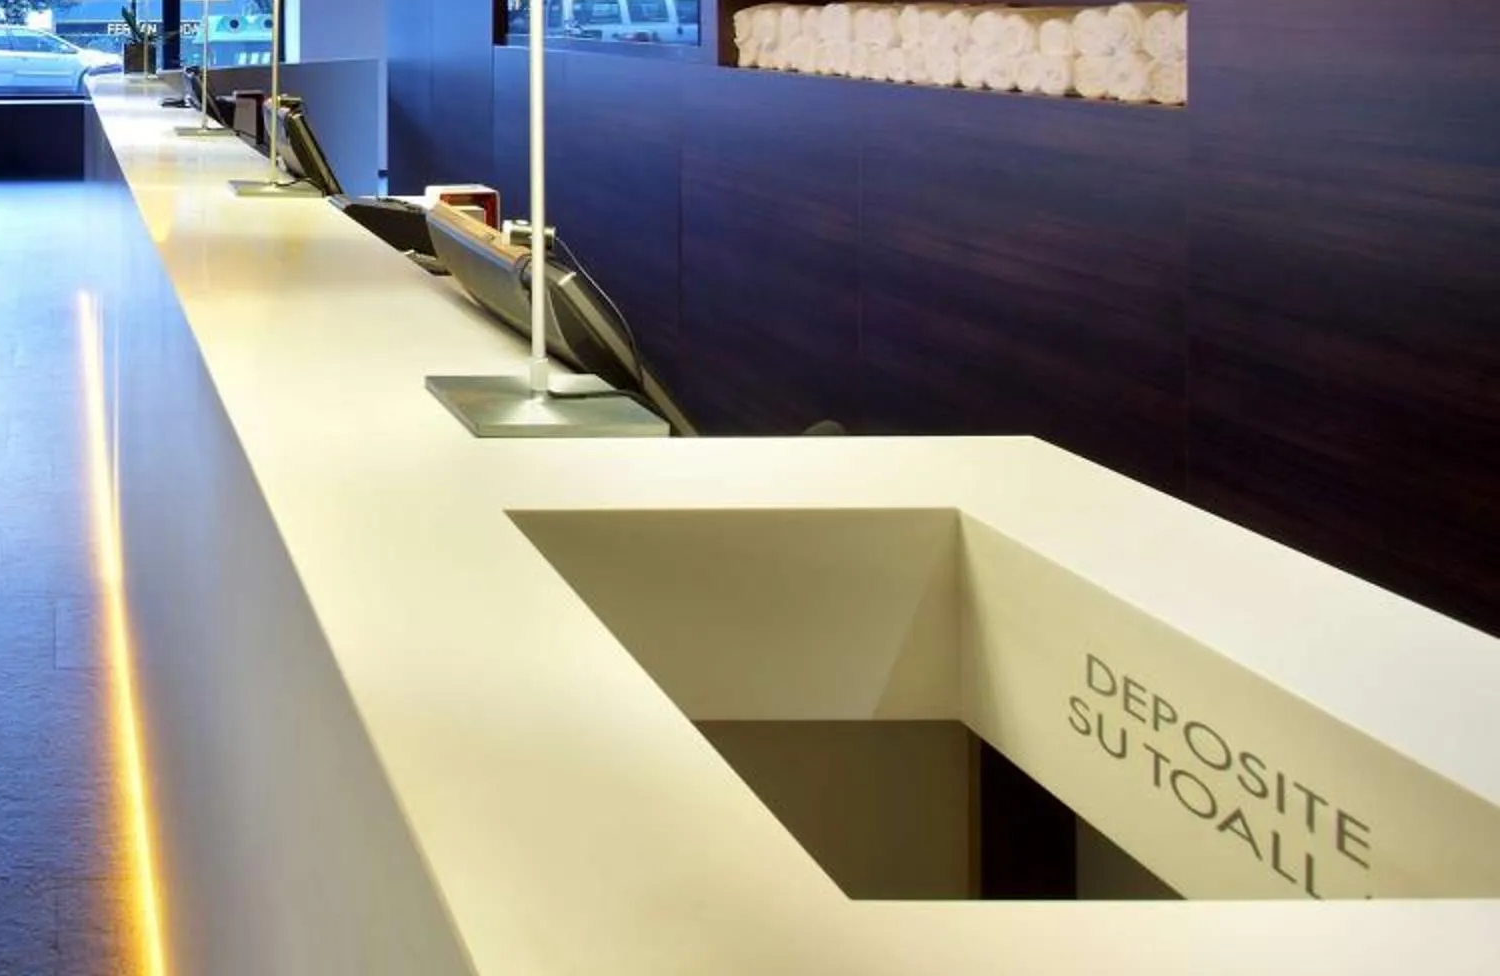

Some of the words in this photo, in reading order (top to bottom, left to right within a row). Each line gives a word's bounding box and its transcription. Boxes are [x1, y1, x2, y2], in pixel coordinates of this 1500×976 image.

[1067, 695, 1128, 760] SU
[1142, 742, 1373, 900] TOALL
[1086, 653, 1371, 870] DEPOSITE
